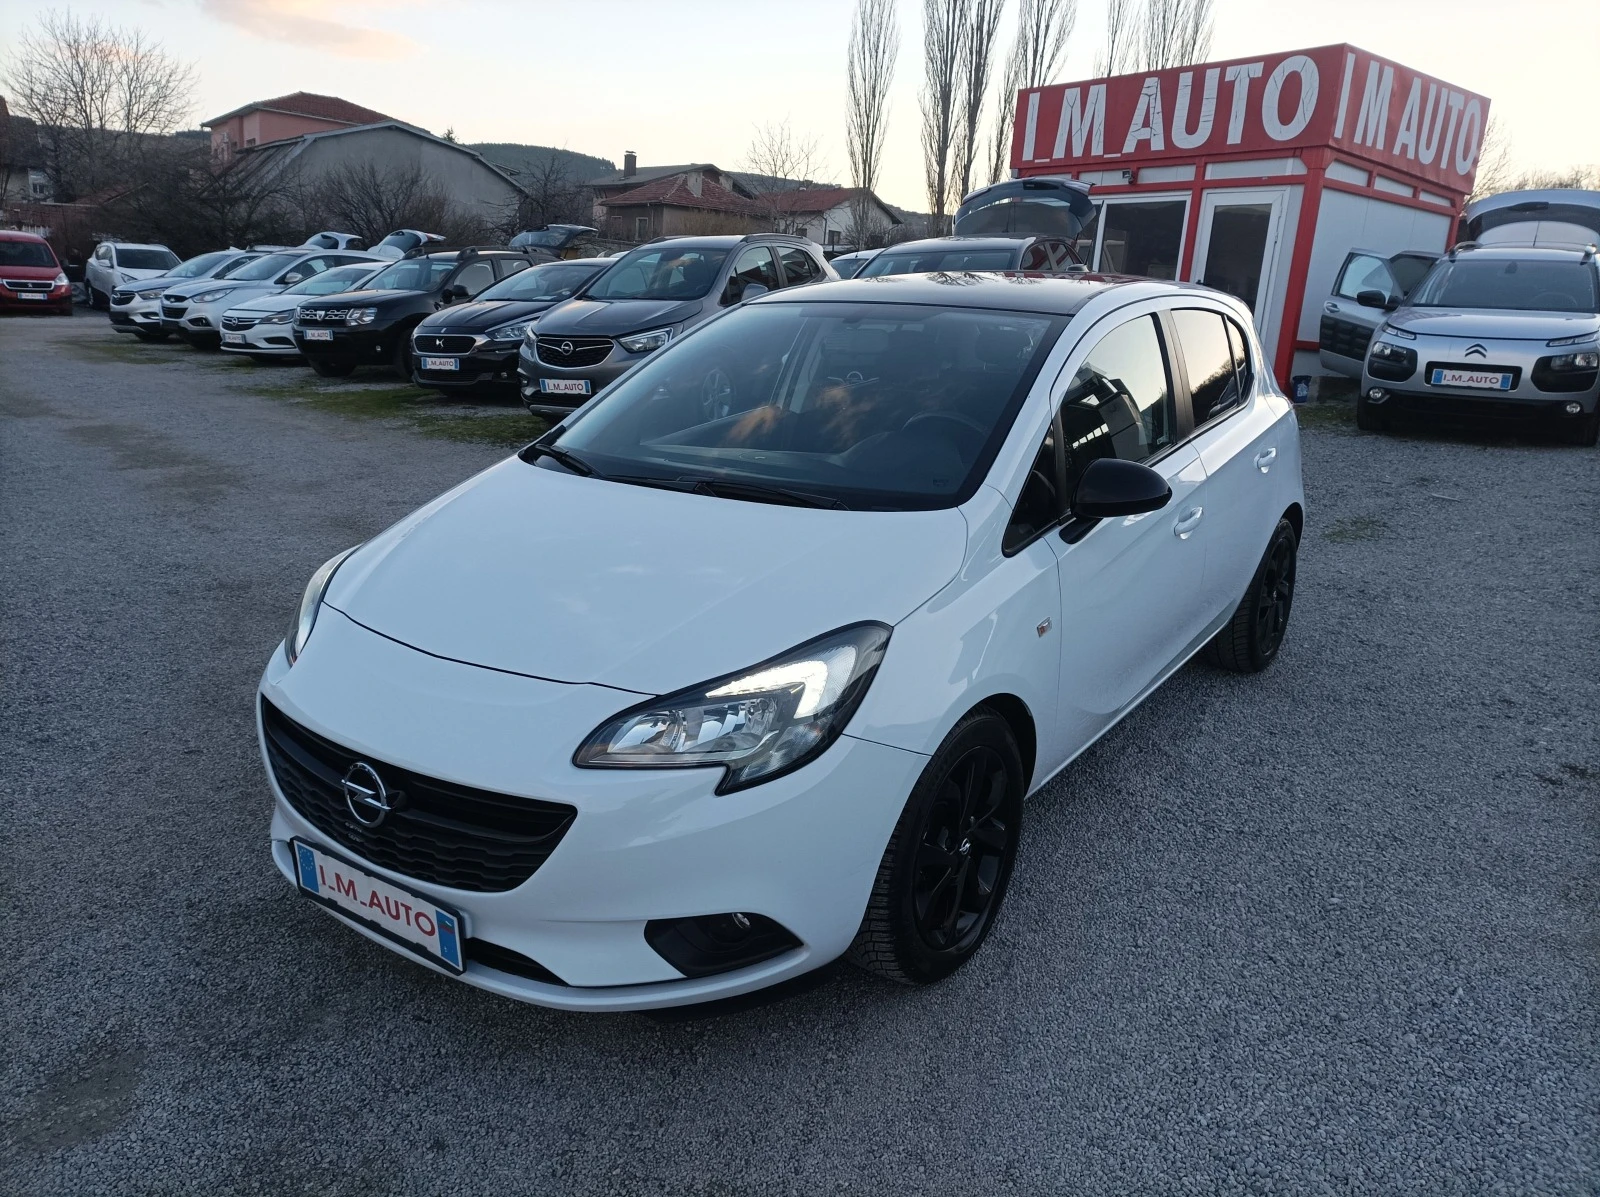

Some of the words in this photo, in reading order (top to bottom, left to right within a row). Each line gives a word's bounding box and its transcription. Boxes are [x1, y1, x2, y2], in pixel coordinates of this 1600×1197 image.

[1333, 52, 1356, 139] I
[1353, 60, 1394, 150] M
[1392, 76, 1481, 176] AUTO
[1443, 374, 1500, 384] I_M_AUTO
[319, 864, 436, 936] I_M_AUTO
